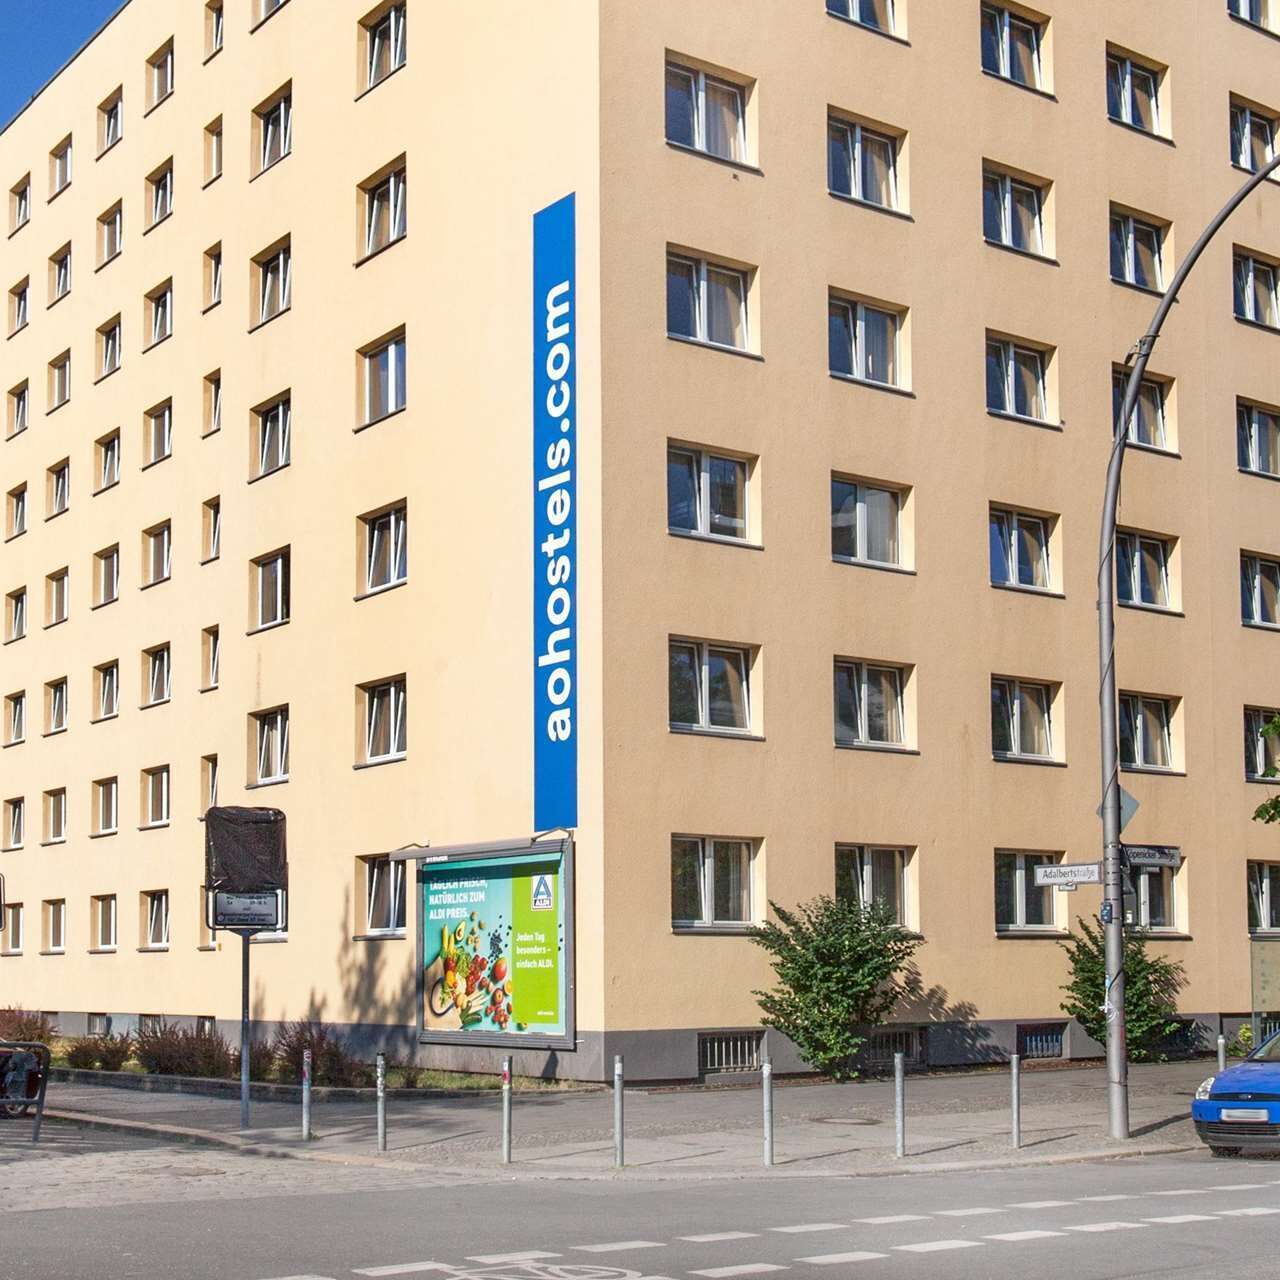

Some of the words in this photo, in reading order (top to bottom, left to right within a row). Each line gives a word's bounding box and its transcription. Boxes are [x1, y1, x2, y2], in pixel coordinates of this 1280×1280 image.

[538, 278, 571, 744] aohostels.com
[1042, 866, 1096, 880] Adalbertstraße
[429, 891, 468, 905] NATÜRLICH
[469, 891, 485, 903] ZUM
[534, 898, 552, 907] ALDI
[429, 908, 445, 920] ALDI
